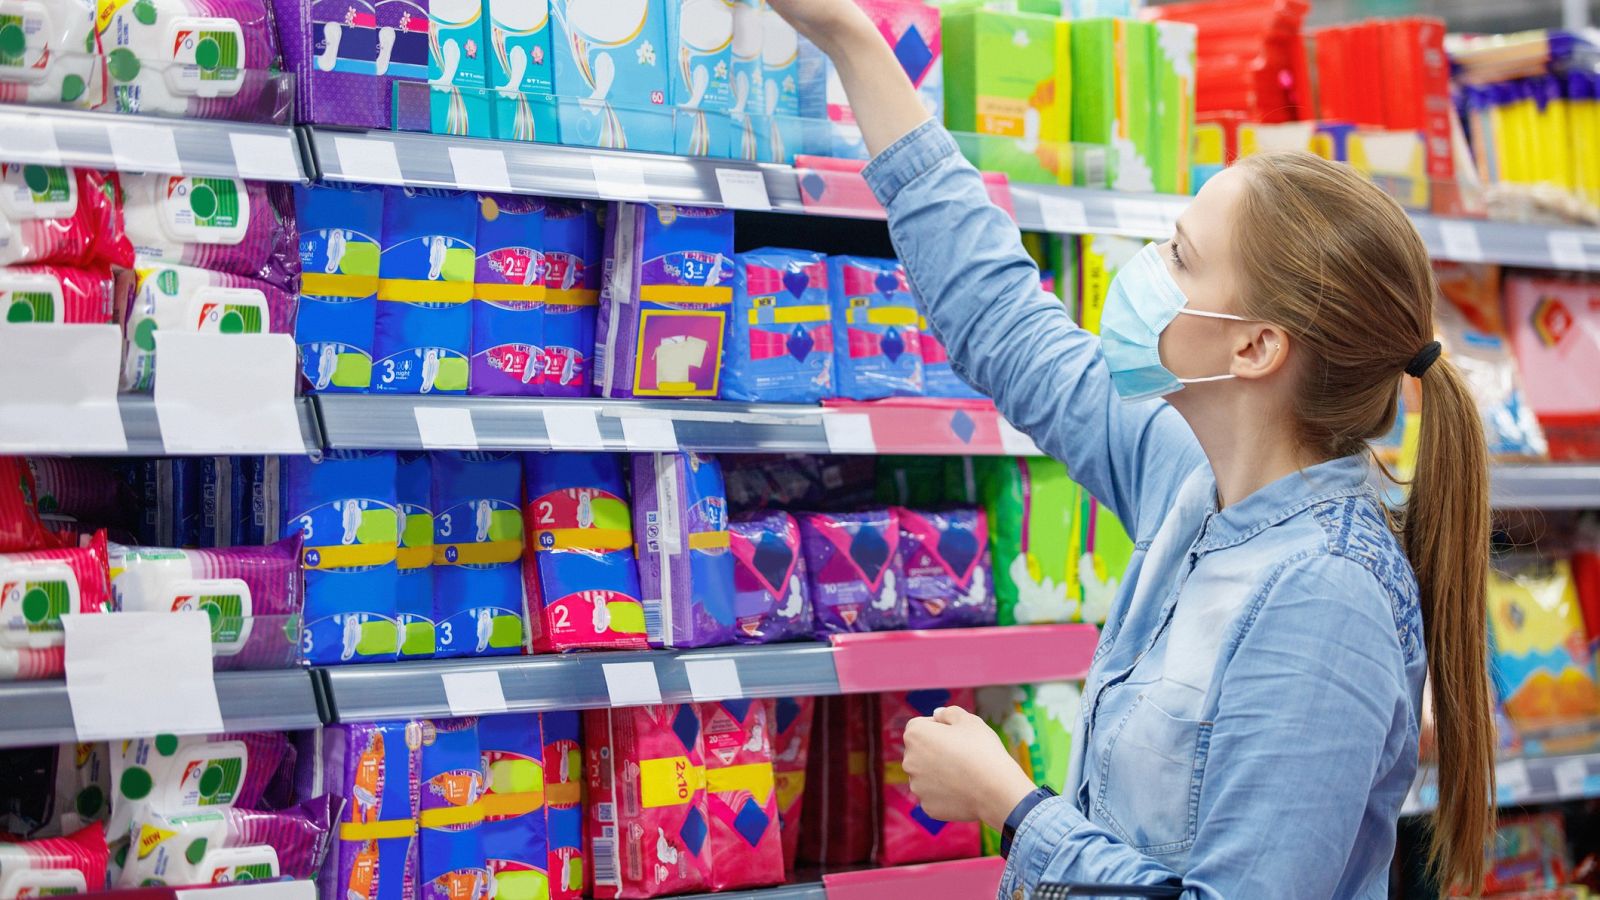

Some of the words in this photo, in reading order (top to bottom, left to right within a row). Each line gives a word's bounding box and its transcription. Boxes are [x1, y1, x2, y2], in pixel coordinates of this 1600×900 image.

[652, 91, 663, 103] 60
[505, 257, 514, 276] 2
[545, 262, 552, 280] 2
[685, 261, 694, 279] 3
[382, 359, 395, 383] 3
[505, 353, 513, 372] 2
[544, 356, 551, 375] 2
[539, 501, 555, 524] 2
[300, 515, 313, 540] 3
[440, 513, 452, 536] 3
[542, 536, 553, 545] 16
[307, 553, 318, 562] 14
[447, 550, 456, 558] 14
[824, 583, 837, 594] 10
[554, 604, 571, 628] 2
[440, 622, 453, 645] 3
[709, 735, 718, 743] 20
[143, 831, 161, 846] NEW
